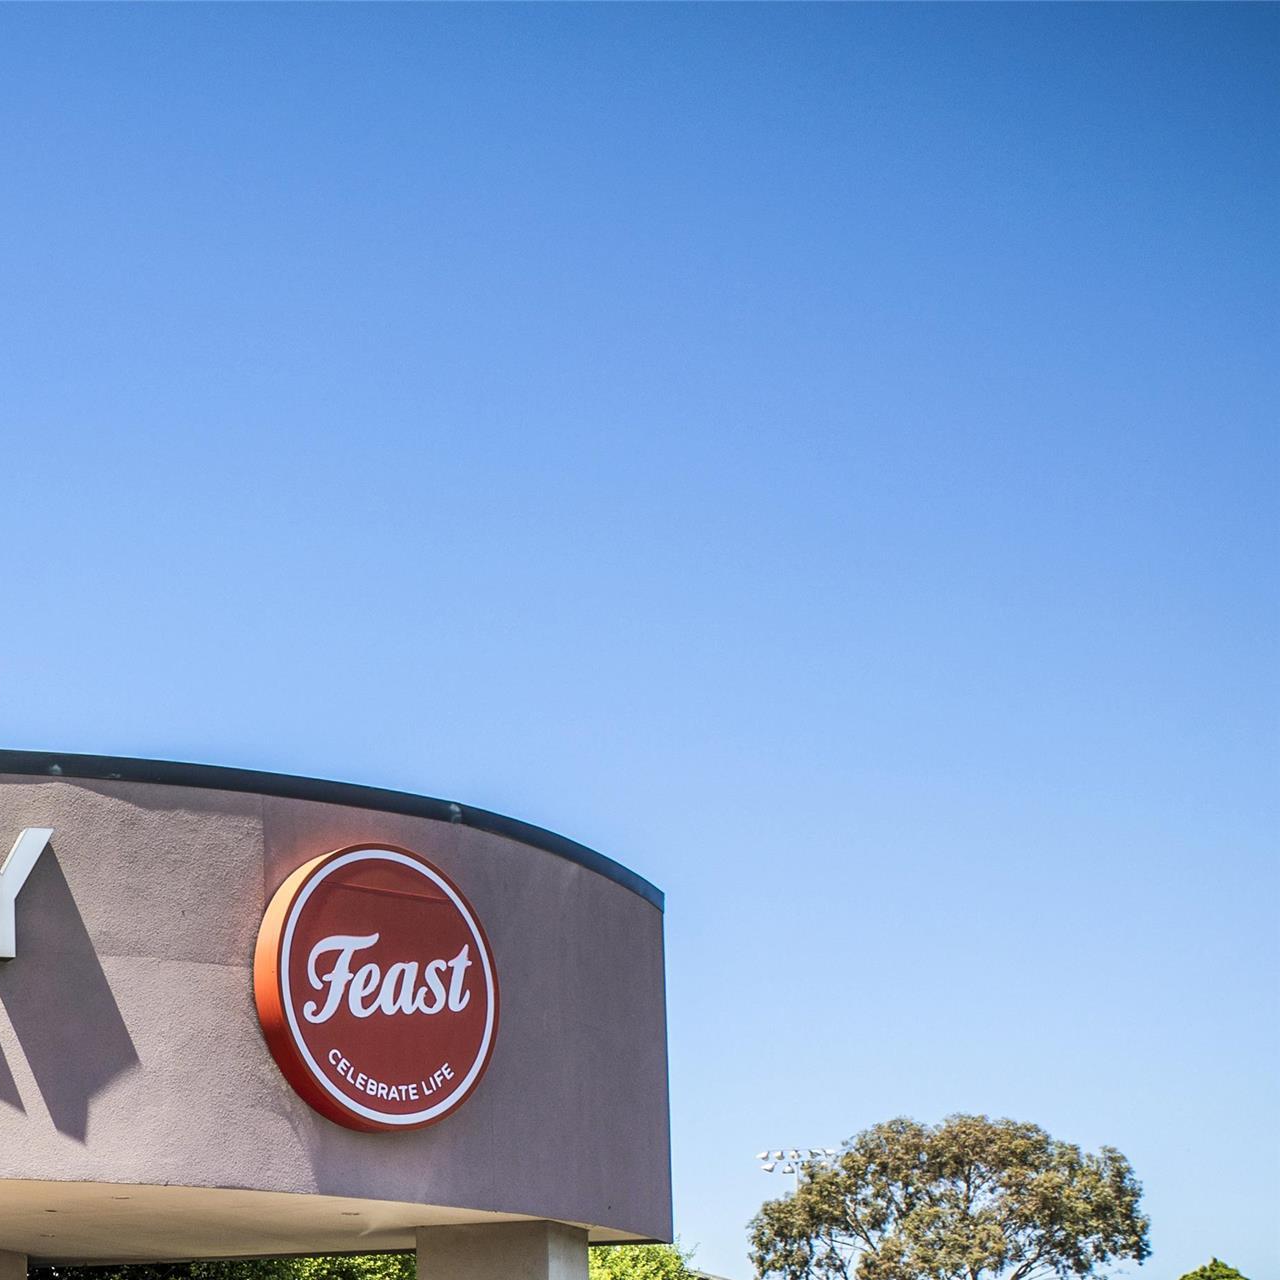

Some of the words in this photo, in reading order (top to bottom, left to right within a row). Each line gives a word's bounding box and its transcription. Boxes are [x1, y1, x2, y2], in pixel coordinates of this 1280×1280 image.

[303, 932, 473, 1024] Feast
[327, 1049, 419, 1101] CELEBRATE
[421, 1062, 456, 1096] LIFE
